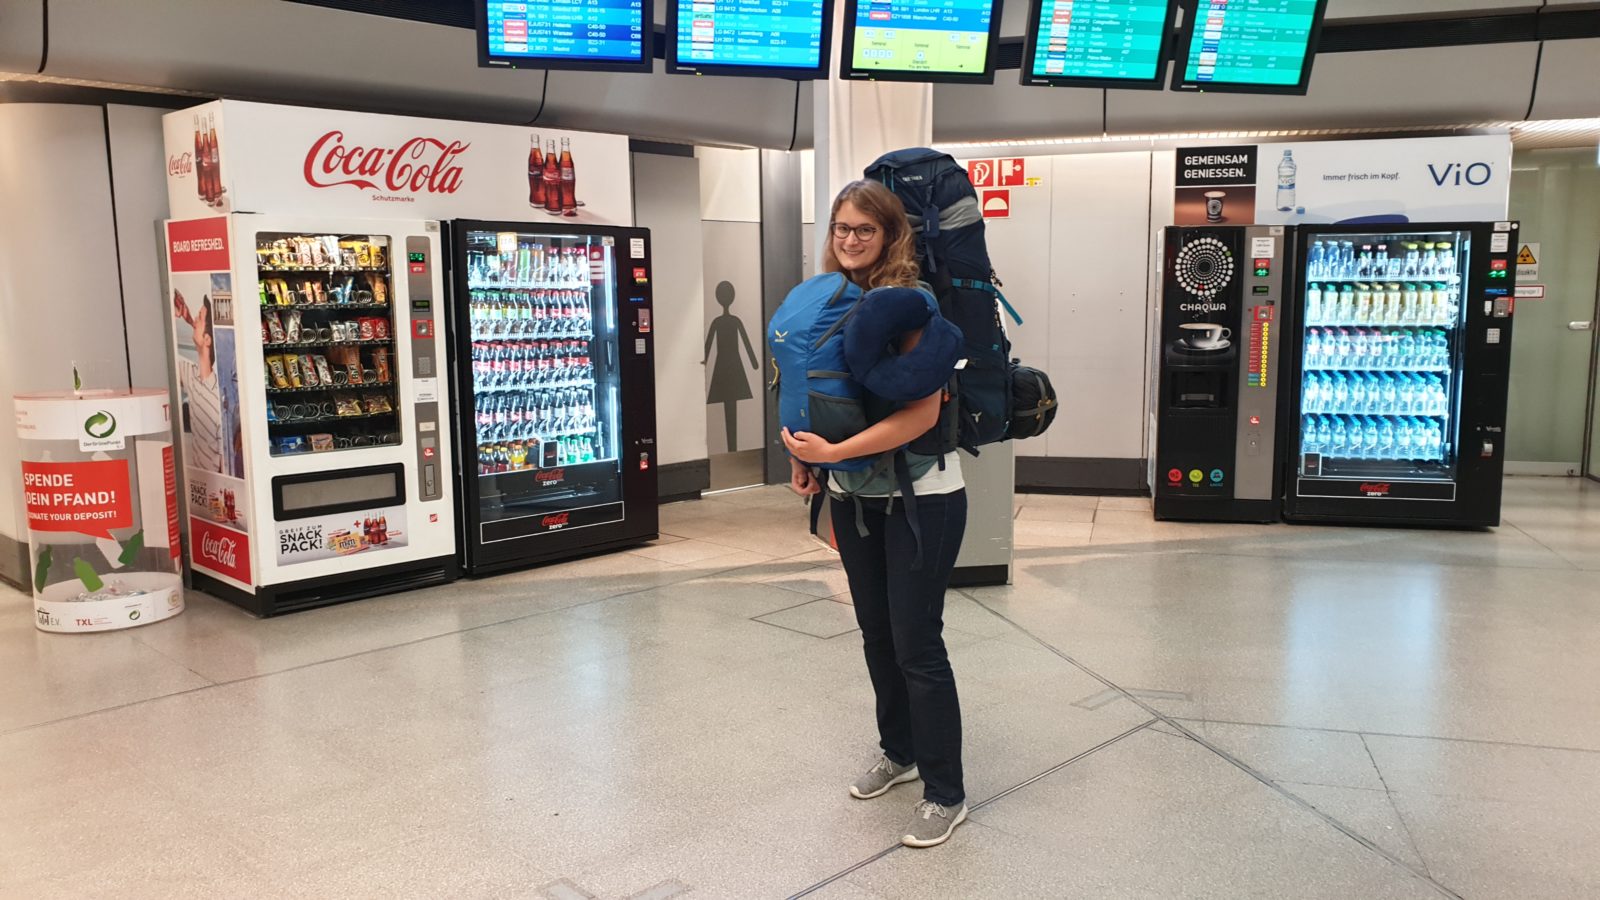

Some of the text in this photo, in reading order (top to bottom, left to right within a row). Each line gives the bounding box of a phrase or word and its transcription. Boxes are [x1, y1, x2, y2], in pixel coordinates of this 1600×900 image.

[1184, 154, 1248, 166] GEMEINSAM
[1184, 168, 1247, 179] GENIESSEN.
[1323, 173, 1346, 181] Immer
[1347, 173, 1369, 182] frisch
[1381, 172, 1401, 181] Kopf.
[1427, 162, 1491, 187] ViO
[372, 194, 415, 202] Schutzmarke
[173, 237, 224, 253] BOARD REFRESHED.
[1180, 303, 1227, 313] CHAQWA
[24, 472, 74, 487] SPENDE
[542, 479, 558, 487] zero
[26, 490, 116, 506] DEIN PFAND!
[50, 513, 72, 521] YOUR
[74, 511, 117, 520] DEPOSIT!
[280, 529, 323, 544] SNACK
[281, 539, 324, 555] PACK!
